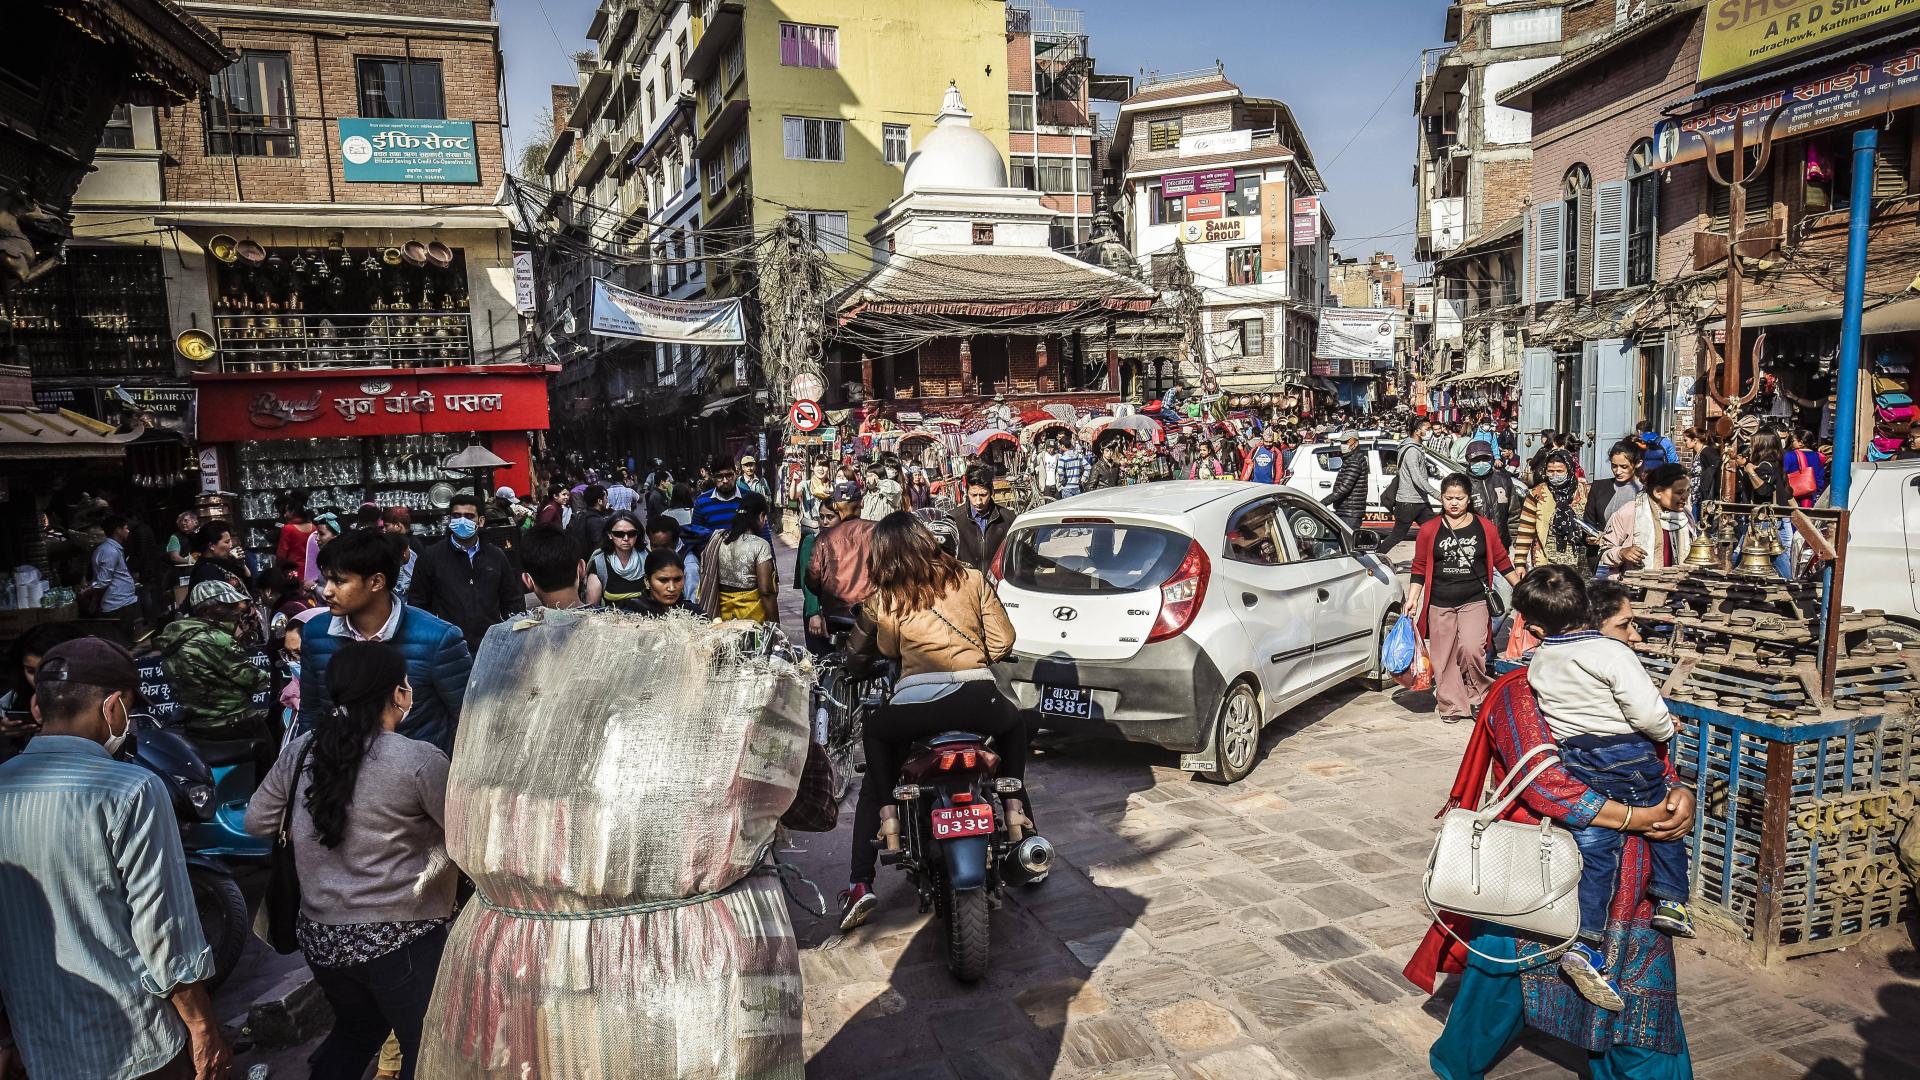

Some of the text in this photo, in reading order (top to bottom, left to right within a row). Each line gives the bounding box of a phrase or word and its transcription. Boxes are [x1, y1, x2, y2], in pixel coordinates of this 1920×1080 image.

[1749, 29, 1816, 57] Indrachowk,
[1820, 5, 1890, 34] Kathmandu
[1206, 220, 1241, 231] SAMAR
[1206, 230, 1241, 241] GROUP
[333, 397, 376, 421] सुन
[443, 393, 502, 412] पसल
